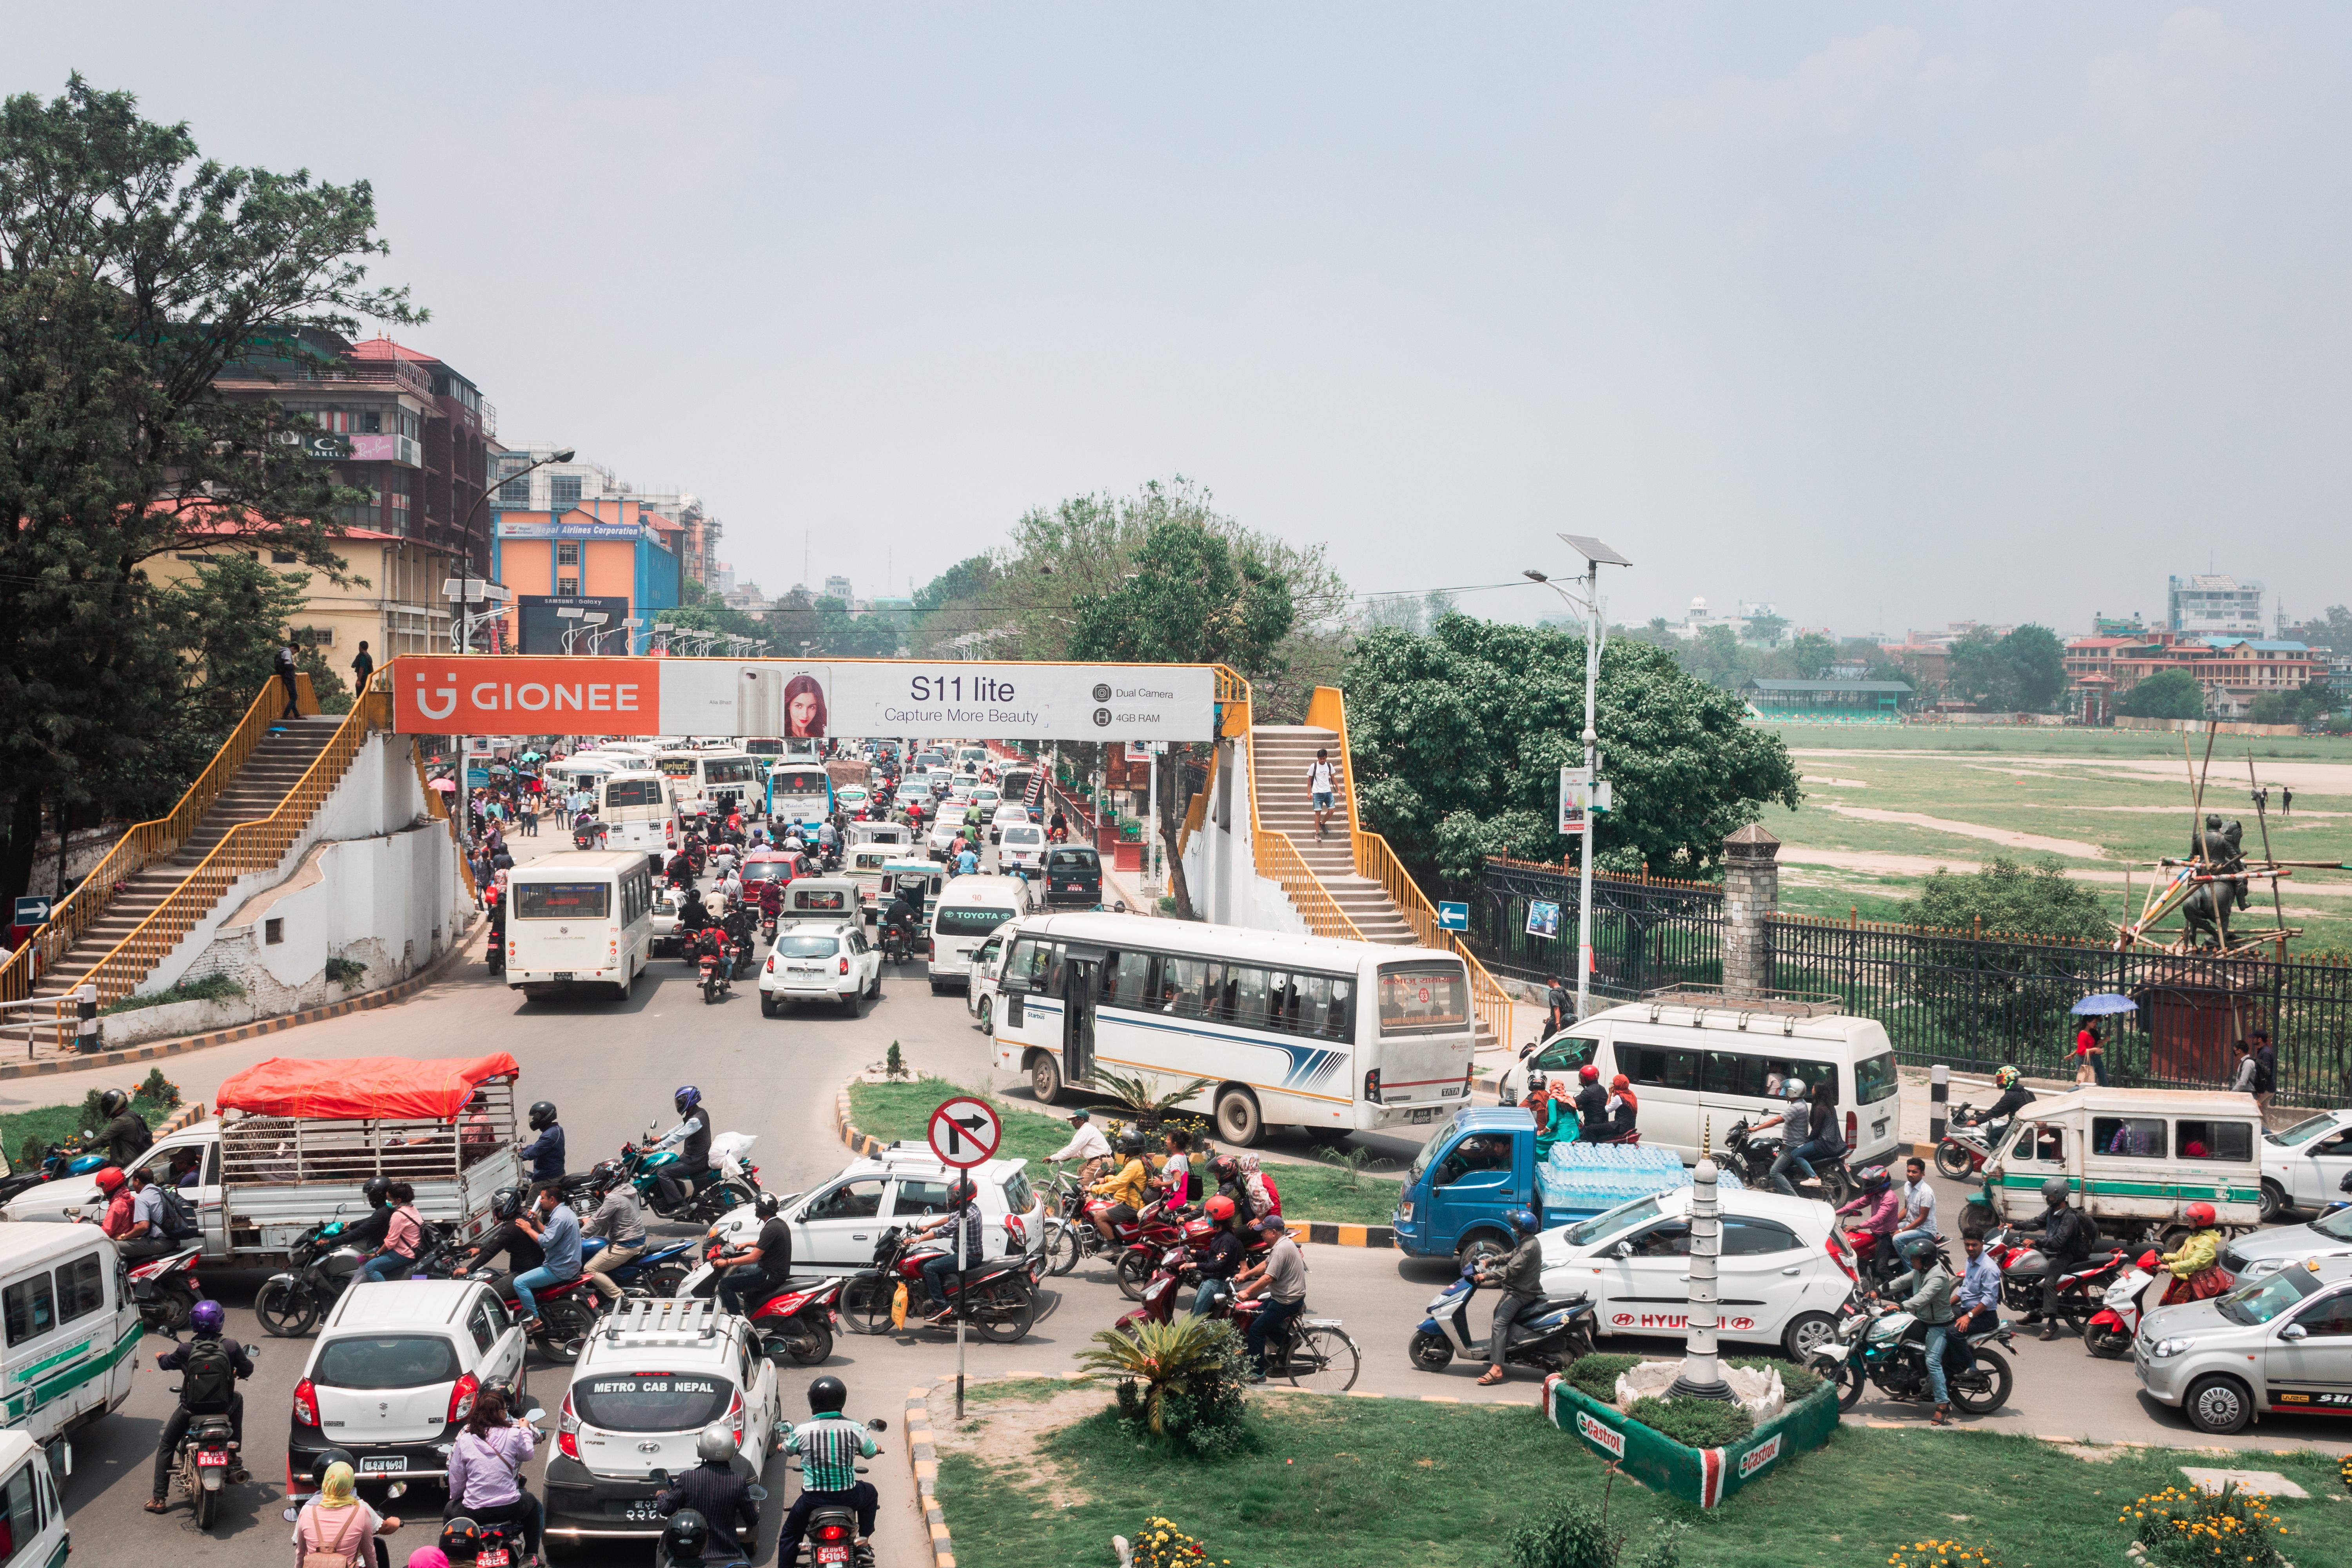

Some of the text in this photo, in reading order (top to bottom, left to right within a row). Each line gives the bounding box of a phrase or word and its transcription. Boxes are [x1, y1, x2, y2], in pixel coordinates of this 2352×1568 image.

[354, 438, 391, 458] Ray-Ban
[535, 526, 558, 535] Nepal
[593, 526, 638, 536] Corporation
[911, 676, 1015, 702] S11 lite
[1116, 689, 1173, 699] Dual Camera
[472, 683, 639, 711] GIONEE
[885, 708, 1039, 726] Capture More Beauty
[1116, 714, 1160, 722] 4GB RAM
[1382, 977, 1417, 985] बालाजु
[1027, 1011, 1045, 1020] Starbus
[594, 1382, 714, 1392] METRO CAB NEPAL
[1587, 1420, 1621, 1452] Castrol
[1748, 1438, 1777, 1470] Castrol
[819, 1552, 848, 1561] ३१७६
